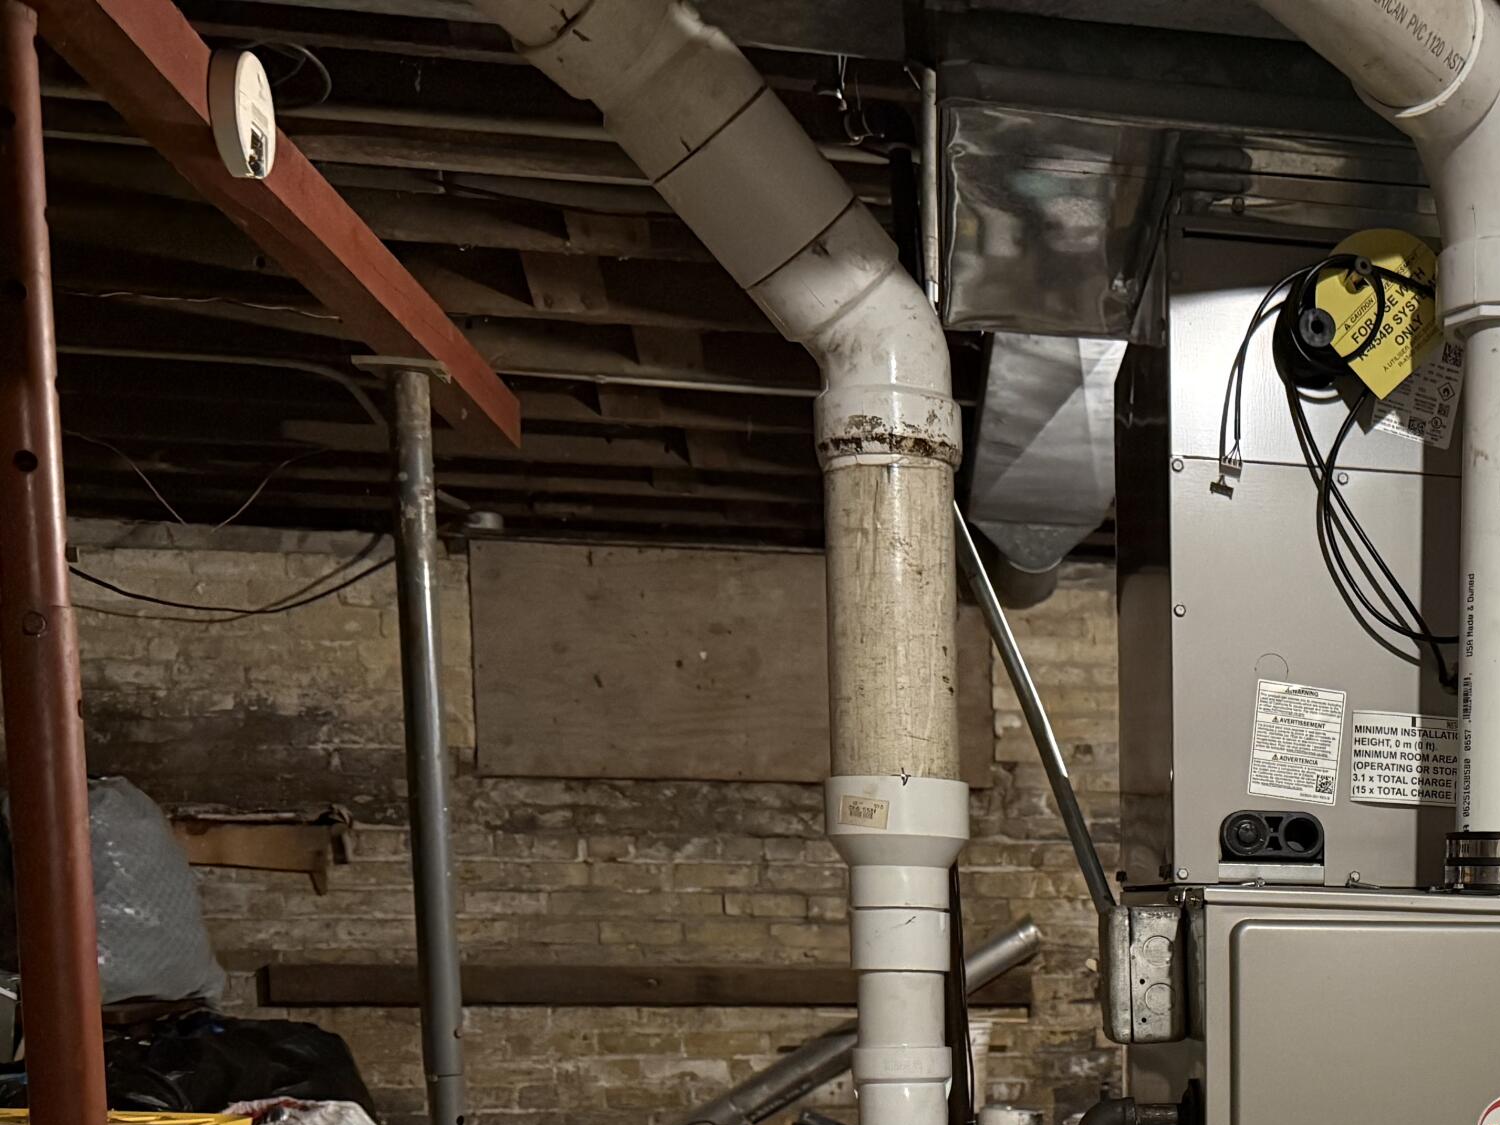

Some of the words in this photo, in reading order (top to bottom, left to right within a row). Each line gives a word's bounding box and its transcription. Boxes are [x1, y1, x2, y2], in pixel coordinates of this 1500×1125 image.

[1406, 13, 1427, 41] PVC
[1424, 31, 1445, 57] 1120
[1350, 297, 1374, 323] CAUTION
[1351, 318, 1376, 344] FOR
[1394, 314, 1423, 346] ONLY
[1466, 639, 1474, 658] USA
[1280, 717, 1326, 729] AVERTISSEMENT
[1354, 725, 1398, 736] MINIMUM
[1401, 728, 1458, 740] INSTALLATI
[1354, 737, 1392, 748] HEIGHT,
[1395, 739, 1401, 748] 0
[1403, 741, 1412, 749] m
[1414, 741, 1423, 751] (0
[1280, 755, 1318, 766] ADVERTENCIA
[1353, 749, 1397, 760] MINIMUM
[1400, 752, 1429, 763] ROOM
[1432, 754, 1458, 764] AREA
[1353, 761, 1413, 773] (OPERATING
[1415, 765, 1429, 774] OR
[1353, 773, 1365, 782] 3.1
[1377, 774, 1408, 785] TOTAL
[1411, 776, 1452, 788] CHARGE
[1352, 785, 1366, 795] (15
[1377, 786, 1408, 797] TOTAL
[1411, 788, 1452, 800] CHARGE
